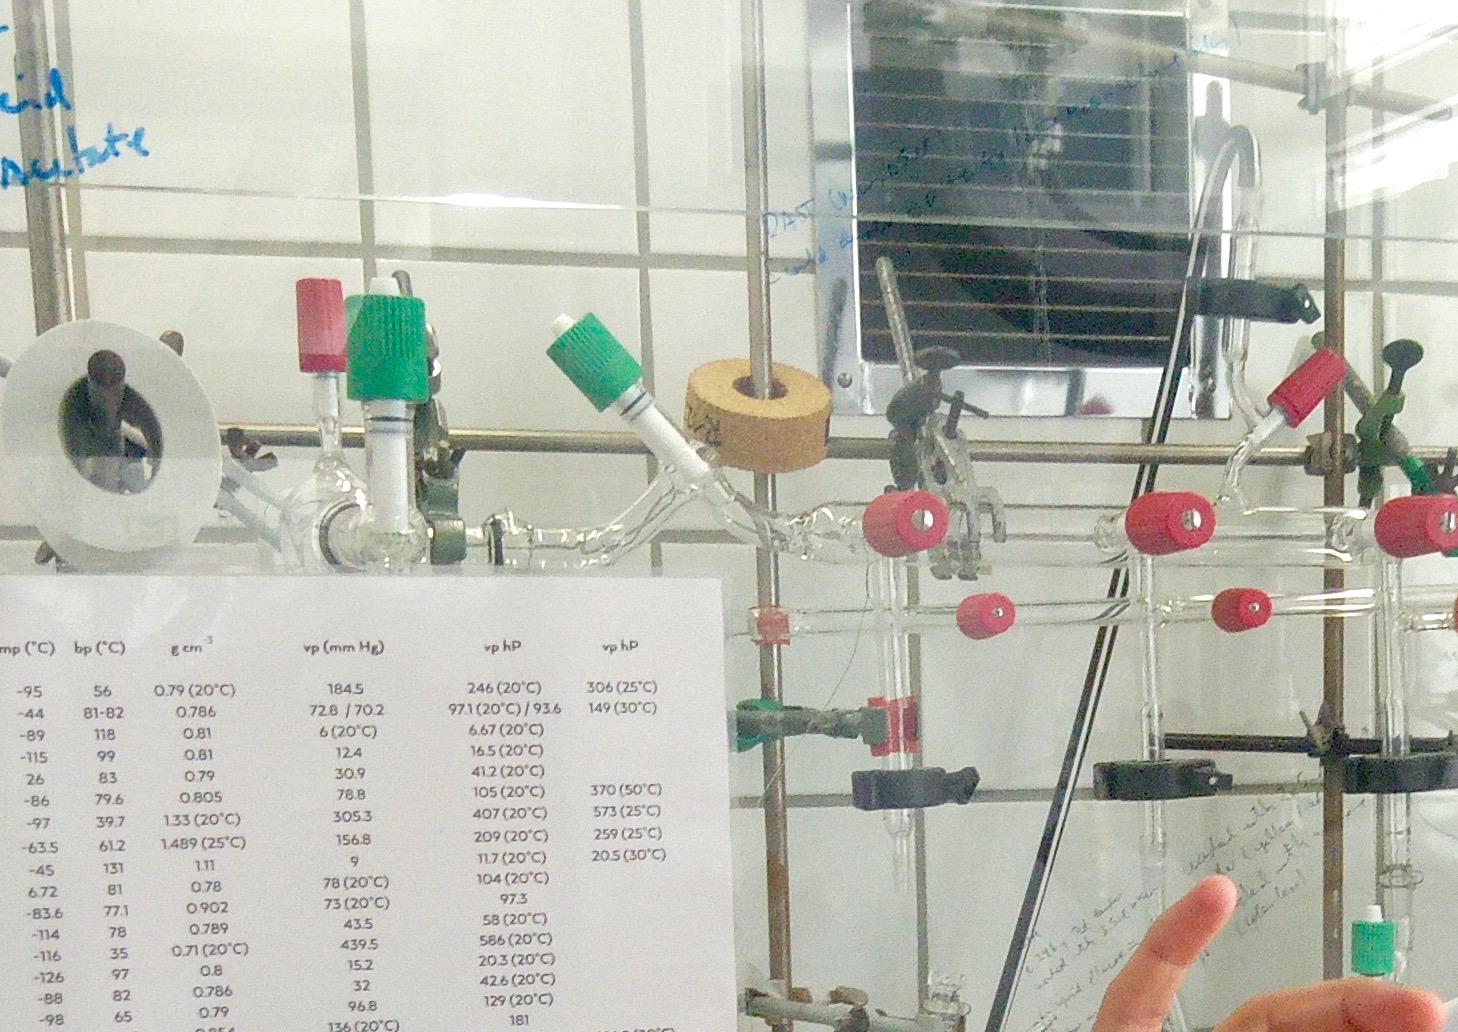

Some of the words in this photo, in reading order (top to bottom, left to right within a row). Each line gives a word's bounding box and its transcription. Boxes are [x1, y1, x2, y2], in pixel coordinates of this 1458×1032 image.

[23, 640, 56, 656] (°C)
[73, 640, 93, 657] bp
[94, 640, 127, 656] (°C)
[303, 644, 321, 656] vp
[322, 639, 356, 655] (mm
[483, 644, 501, 655] vp
[501, 639, 522, 652] hP
[601, 644, 619, 655] vp
[619, 639, 640, 651] hP
[17, 685, 43, 698] -95
[93, 684, 113, 698] 56
[187, 683, 237, 698] (20°C)
[467, 682, 495, 694] 246
[495, 681, 543, 696] (20°C)
[587, 681, 614, 693] 306
[615, 680, 658, 695] (25°C)
[18, 708, 45, 719] -44
[83, 706, 125, 720] 81-82
[588, 702, 612, 713] 149
[613, 701, 658, 715] (30°C)
[19, 729, 46, 742] -89
[94, 728, 116, 741] 118
[318, 726, 329, 738] 6
[330, 724, 378, 739] (20°C)
[498, 722, 545, 737] (20°C)
[20, 751, 49, 764] -115
[96, 750, 116, 762] 99
[498, 743, 545, 758] (20°C)
[26, 773, 45, 786] 26
[98, 771, 118, 784] 83
[473, 786, 498, 798] 105
[499, 785, 546, 799] (20°C)
[591, 784, 617, 796] 370
[618, 783, 663, 797] (50°C)
[24, 795, 50, 807] -86
[472, 808, 501, 820] 407
[501, 806, 548, 821] (20°C)
[593, 806, 618, 818] 573
[619, 804, 662, 819] (25°C)
[27, 817, 51, 829] -97
[473, 831, 502, 843] 209
[503, 829, 549, 844] (20°C)
[594, 828, 619, 840] 259
[620, 826, 663, 841] (25°C)
[22, 841, 59, 854] -63.5
[200, 836, 247, 851] (25°C)
[349, 856, 360, 867] 9
[622, 848, 667, 863] (30°C)
[29, 864, 55, 877] -45
[103, 862, 124, 875] 131
[323, 877, 341, 889] 78
[342, 875, 390, 890] (20°C)
[476, 873, 502, 885] 104
[503, 871, 550, 886] (20°C)
[107, 883, 123, 896] 81
[324, 898, 342, 910] 73
[343, 896, 391, 911] (20°C)
[26, 907, 64, 920] -83.6
[482, 914, 501, 926] 58
[502, 912, 548, 927] (20°C)
[32, 929, 61, 940] -114
[108, 926, 128, 938] 78
[479, 934, 507, 946] 586
[507, 932, 554, 947] (20°C)
[34, 950, 62, 962] -116
[110, 947, 129, 960] 35
[201, 942, 250, 958] (20°C)
[510, 952, 556, 967] (20°C)
[34, 971, 65, 984] -126
[111, 968, 130, 980] 97
[353, 979, 371, 992] 32
[38, 992, 64, 1005] -88
[112, 989, 131, 1002] 82
[483, 995, 507, 1007] 129
[508, 992, 555, 1008] (20°C)
[39, 1013, 65, 1026] -98
[113, 1010, 133, 1023] 65
[509, 1014, 530, 1026] 181
